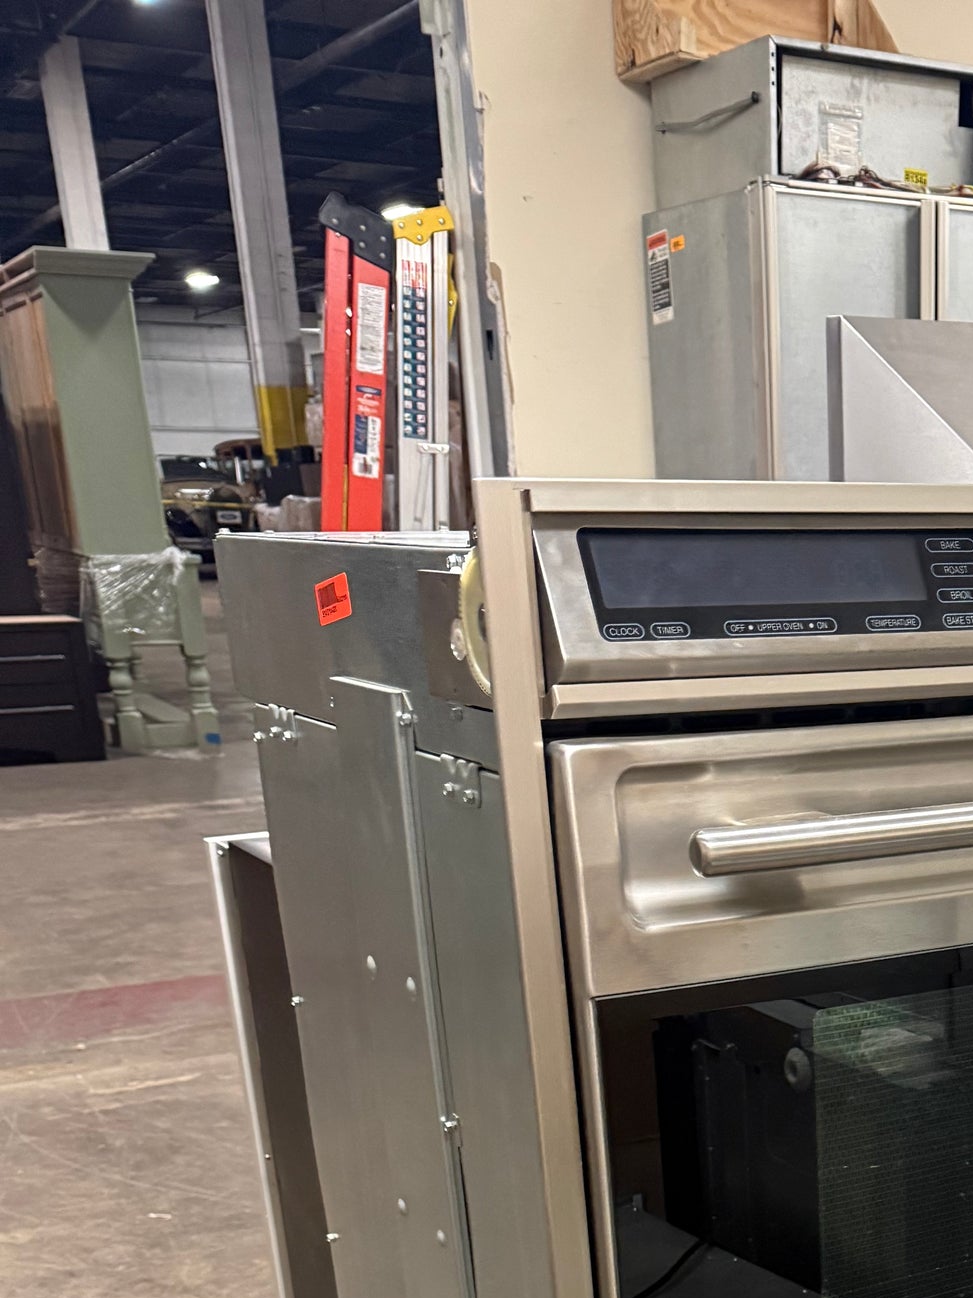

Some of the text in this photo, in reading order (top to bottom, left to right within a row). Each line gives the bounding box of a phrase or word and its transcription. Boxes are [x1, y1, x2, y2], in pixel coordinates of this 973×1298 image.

[940, 540, 961, 550] BAKE
[943, 565, 968, 575] ROAST
[950, 590, 973, 600] BROIL
[870, 618, 917, 628] TEMPERATURE
[946, 615, 966, 625] BAKE
[609, 626, 640, 637] CLOCK
[656, 625, 684, 635] TIMER
[730, 621, 828, 632] OFF UPPER OVEN ON
